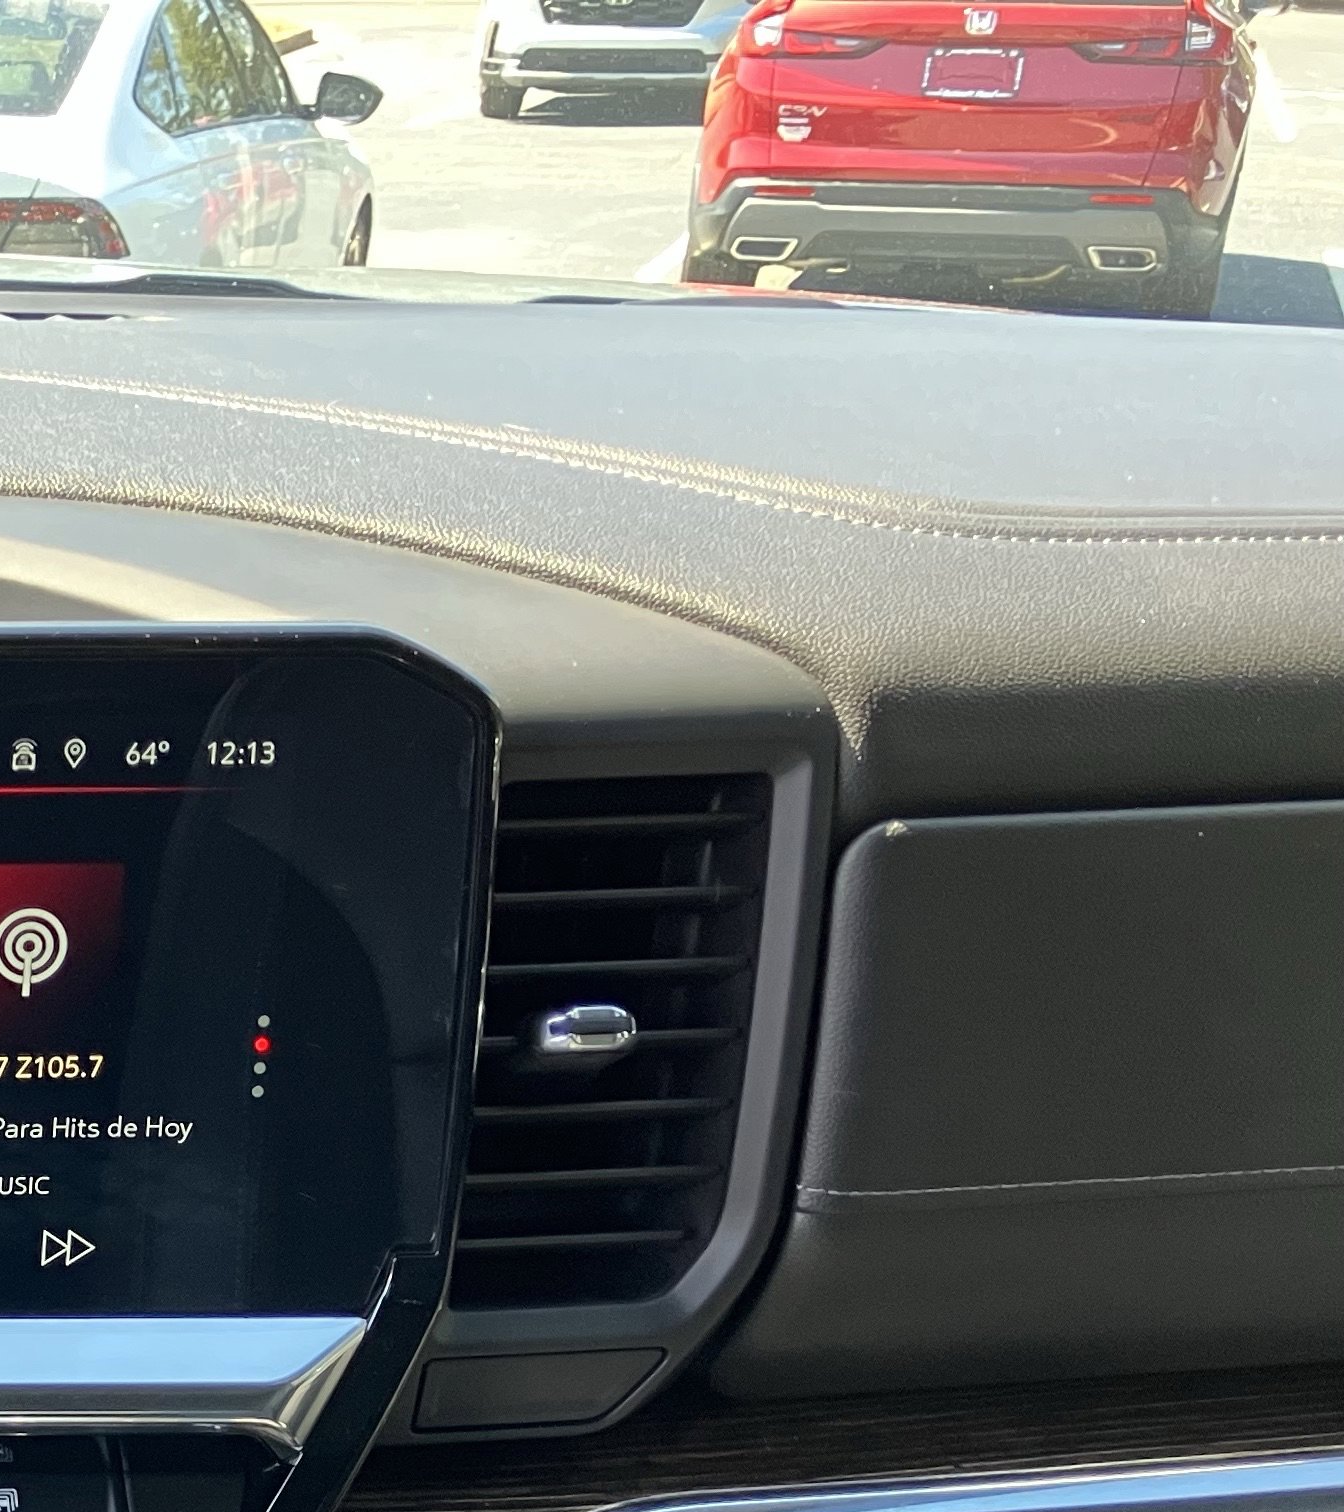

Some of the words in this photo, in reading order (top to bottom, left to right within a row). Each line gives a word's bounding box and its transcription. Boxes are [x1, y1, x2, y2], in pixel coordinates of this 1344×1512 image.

[207, 740, 276, 766] 12:13
[14, 1055, 105, 1079] Z105.7
[52, 1116, 100, 1139] Hits
[107, 1116, 138, 1139] de
[145, 1116, 194, 1143] Hoy
